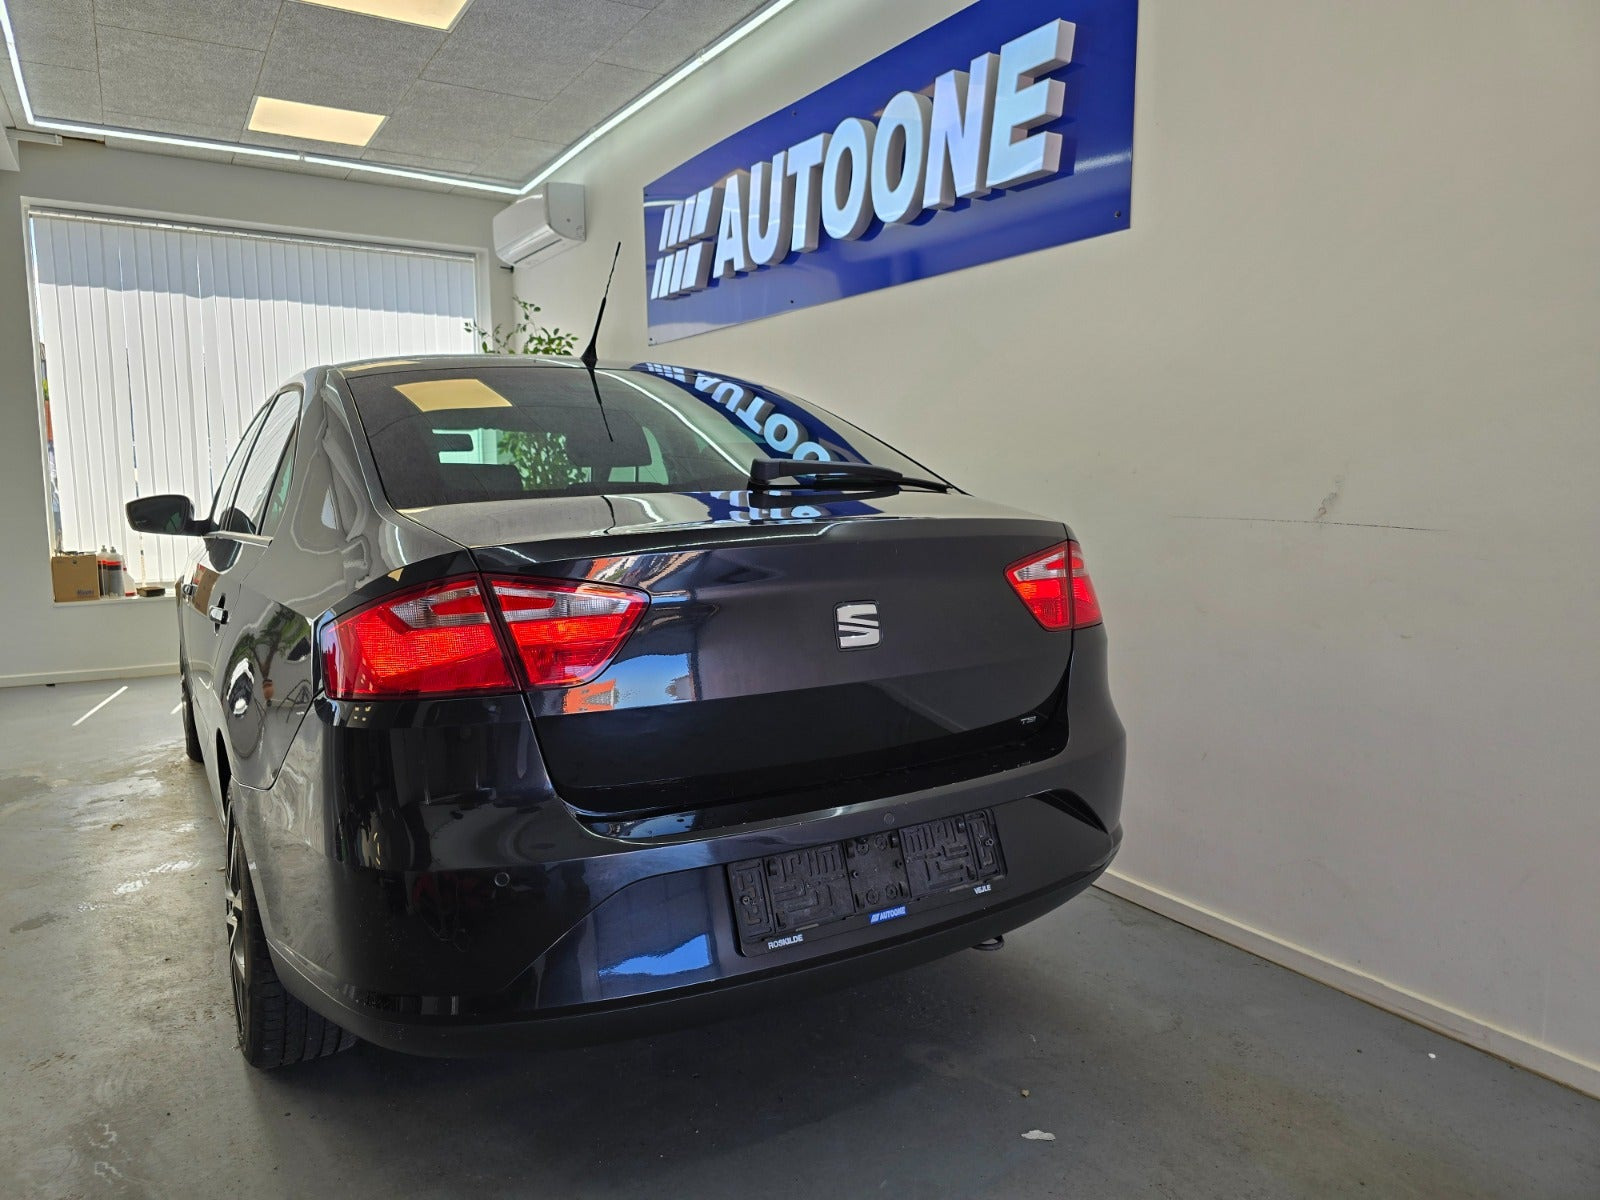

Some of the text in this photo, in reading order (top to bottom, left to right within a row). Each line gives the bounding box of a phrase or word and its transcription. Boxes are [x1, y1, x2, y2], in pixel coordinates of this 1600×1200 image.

[713, 18, 1076, 279] AUTOONE
[879, 906, 906, 921] AUTOONE
[767, 934, 804, 950] ROSKILDE
